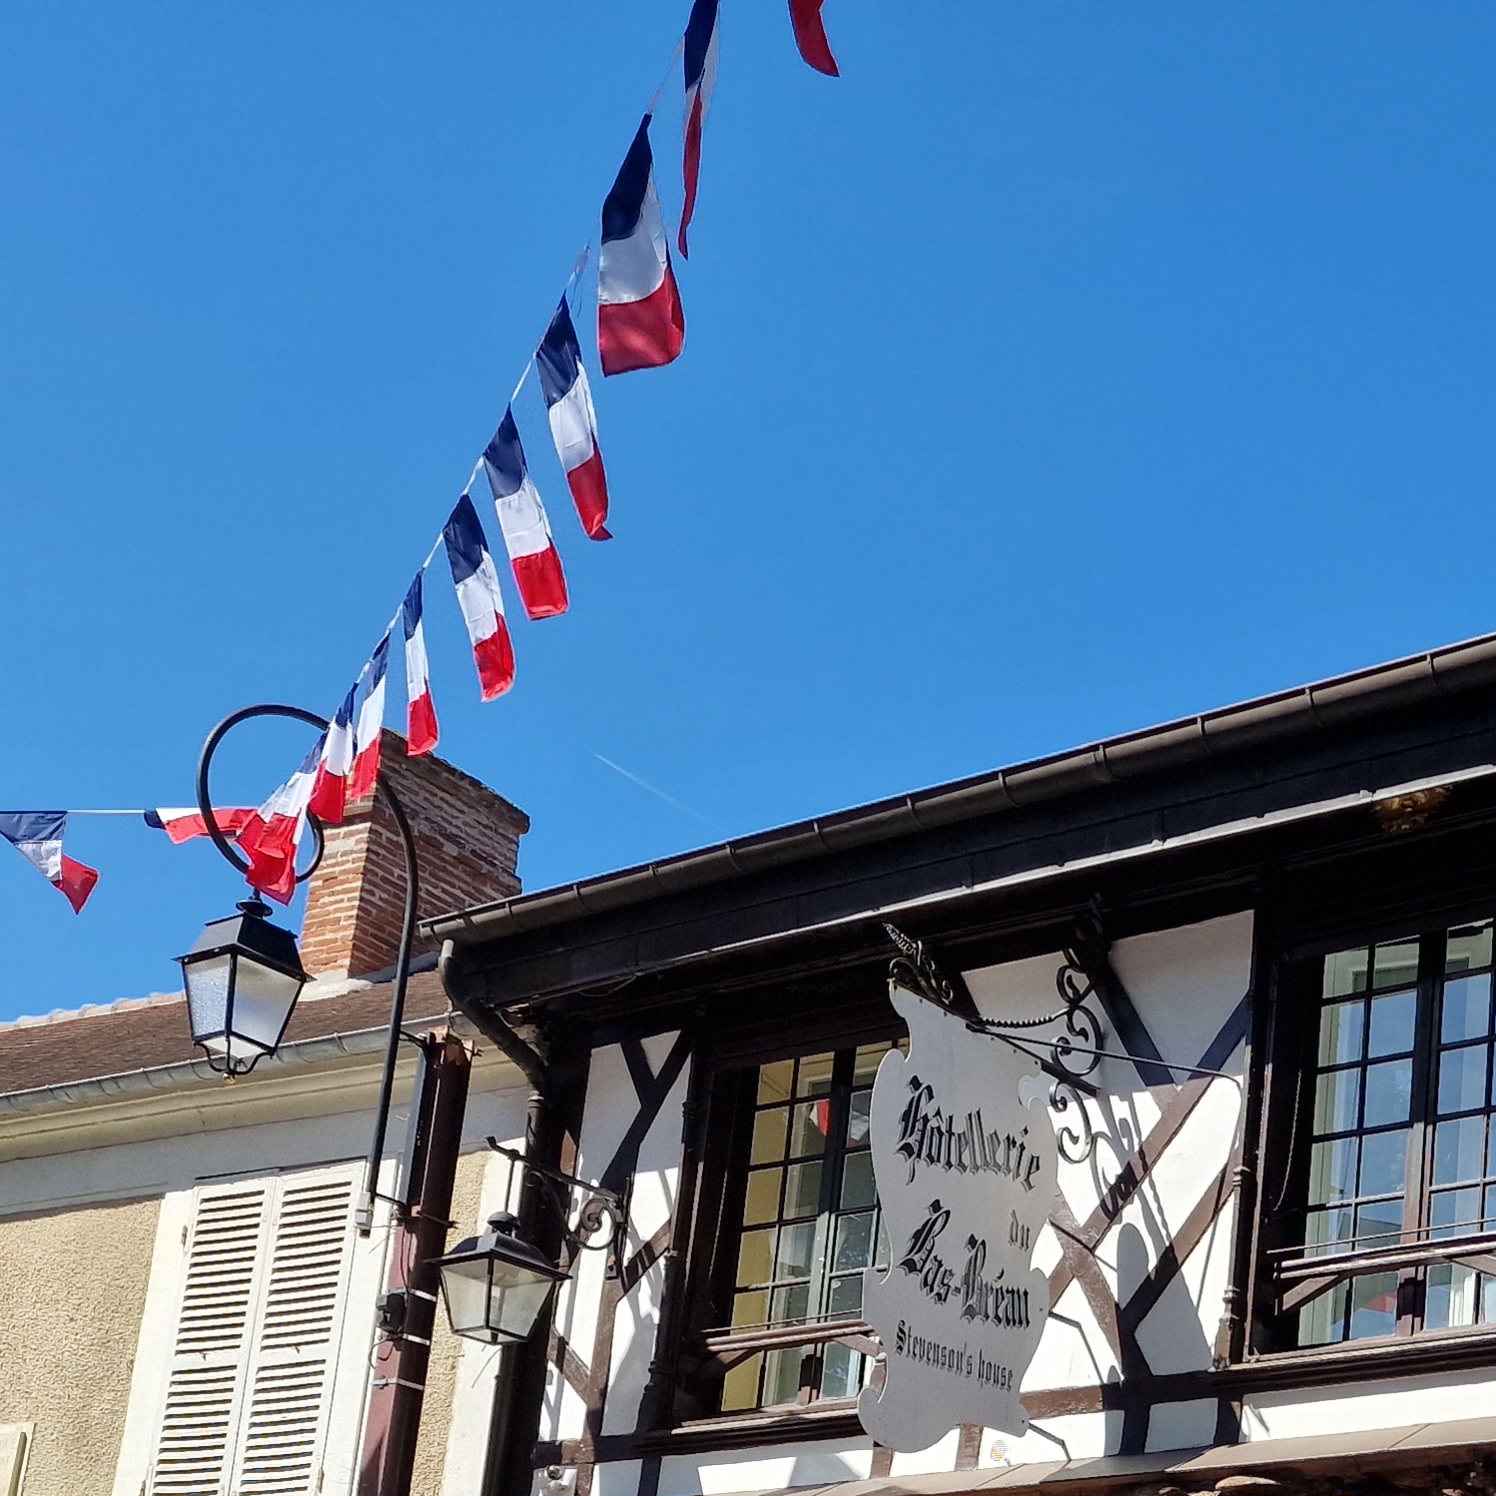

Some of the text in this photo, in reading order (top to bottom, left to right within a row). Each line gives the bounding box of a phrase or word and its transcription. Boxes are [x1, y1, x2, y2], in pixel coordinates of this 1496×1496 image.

[894, 1074, 1040, 1193] Hôtellerie
[1008, 1209, 1030, 1251] du
[895, 1319, 1013, 1393] Stevenson's house
